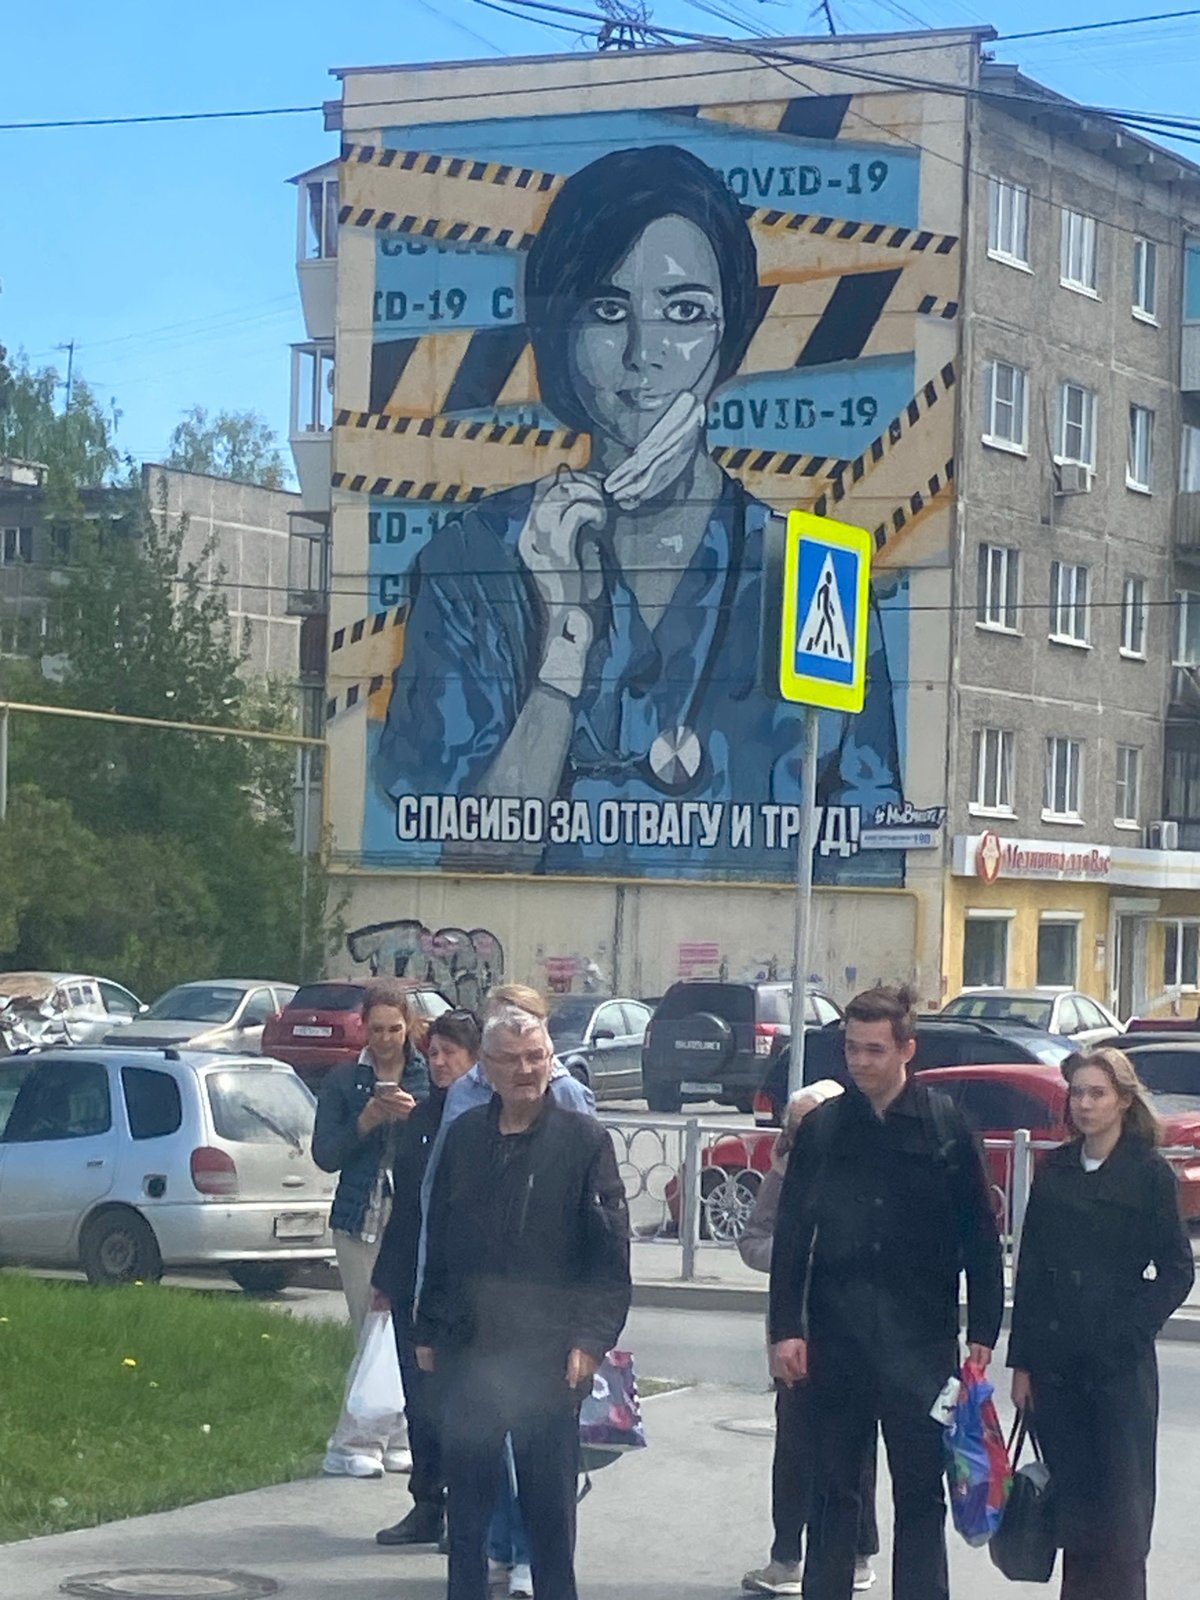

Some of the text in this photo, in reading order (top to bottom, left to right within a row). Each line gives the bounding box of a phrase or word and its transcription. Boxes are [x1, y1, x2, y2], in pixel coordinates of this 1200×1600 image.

[716, 160, 888, 200] OVID-19
[397, 795, 543, 842] СПАСИБО
[549, 799, 592, 844] ЗА
[598, 801, 723, 847] ОТВАГУ
[730, 804, 751, 848] И
